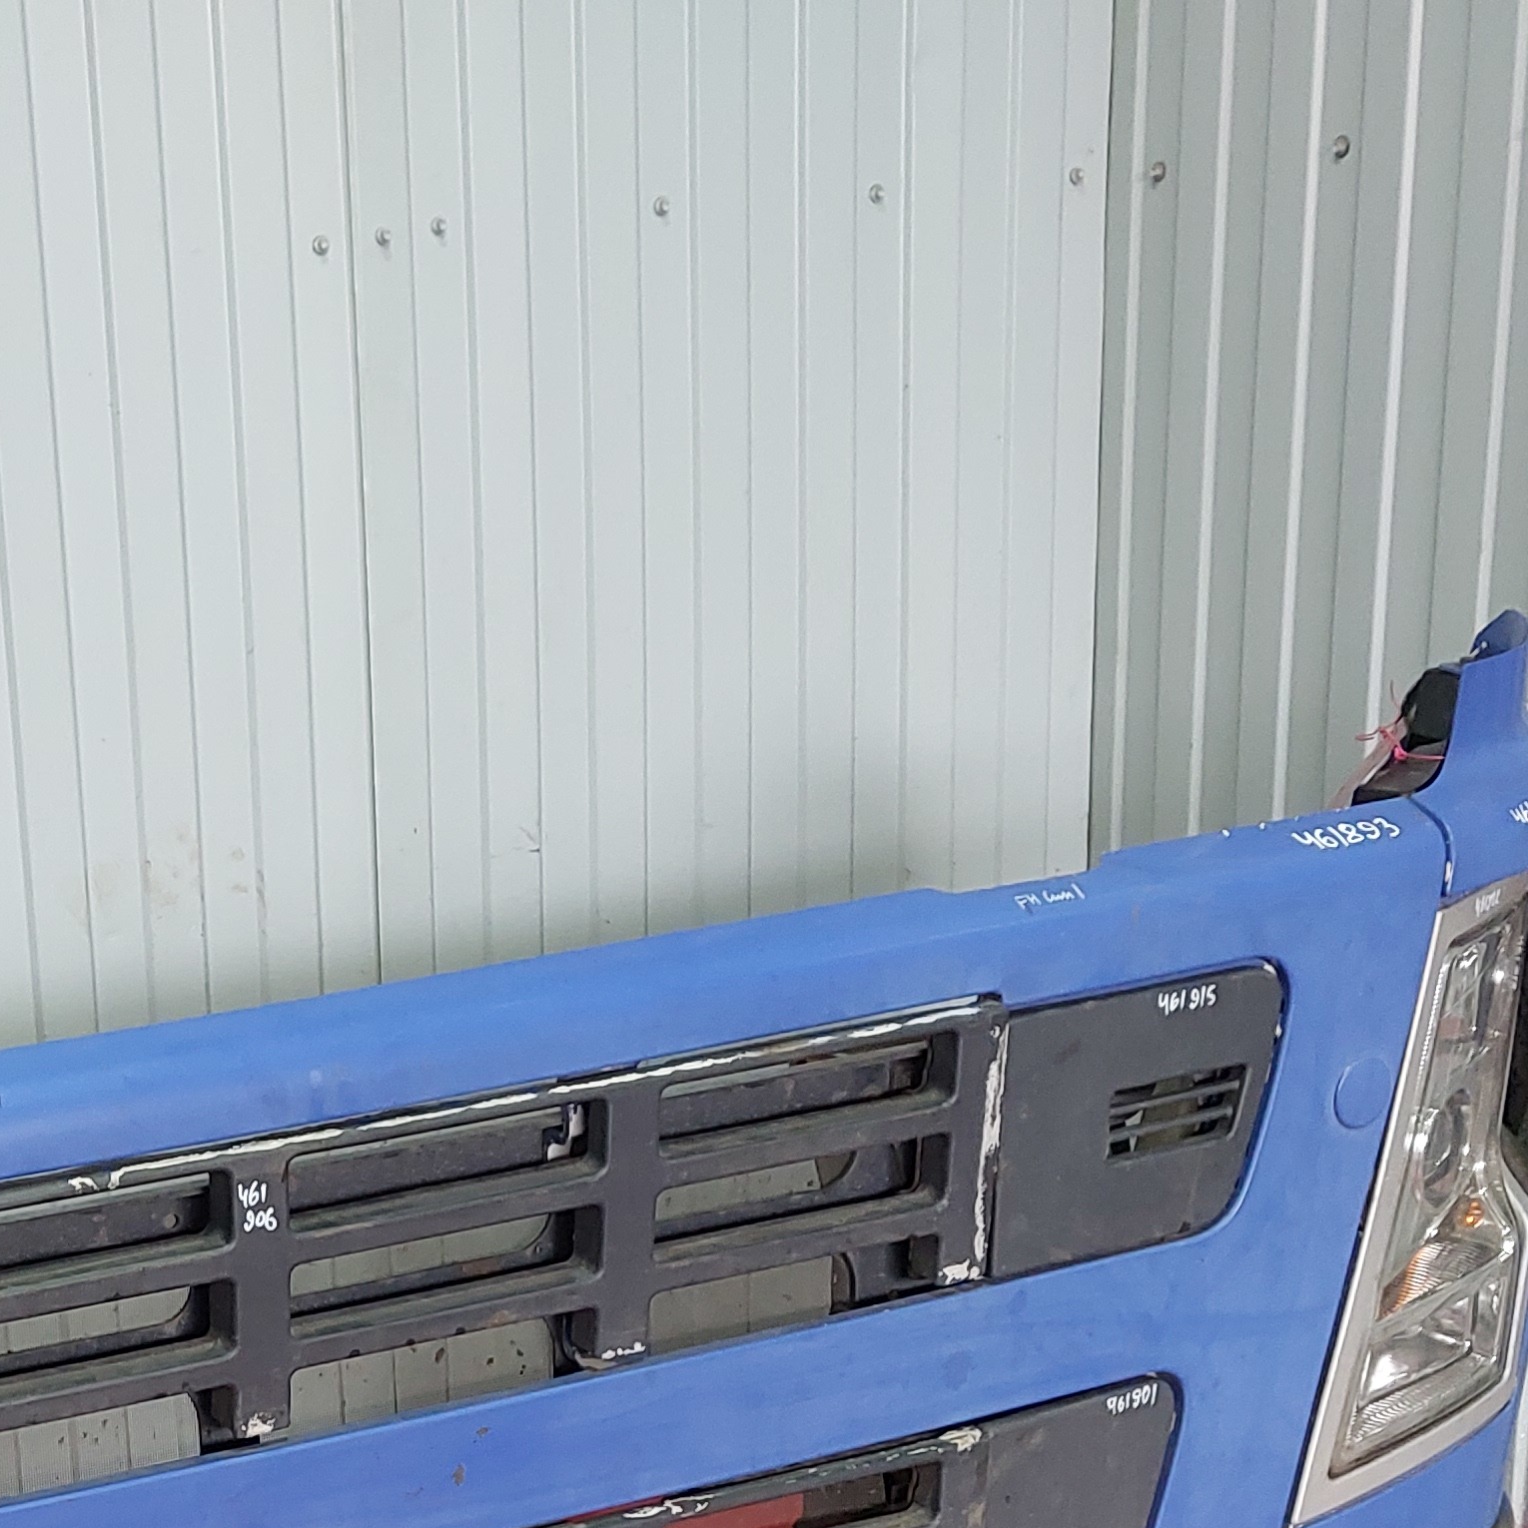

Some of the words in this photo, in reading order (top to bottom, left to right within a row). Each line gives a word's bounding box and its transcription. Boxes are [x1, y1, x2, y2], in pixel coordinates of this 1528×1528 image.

[1291, 816, 1400, 850] 461893
[238, 1180, 268, 1209] 461
[243, 1206, 278, 1232] 906
